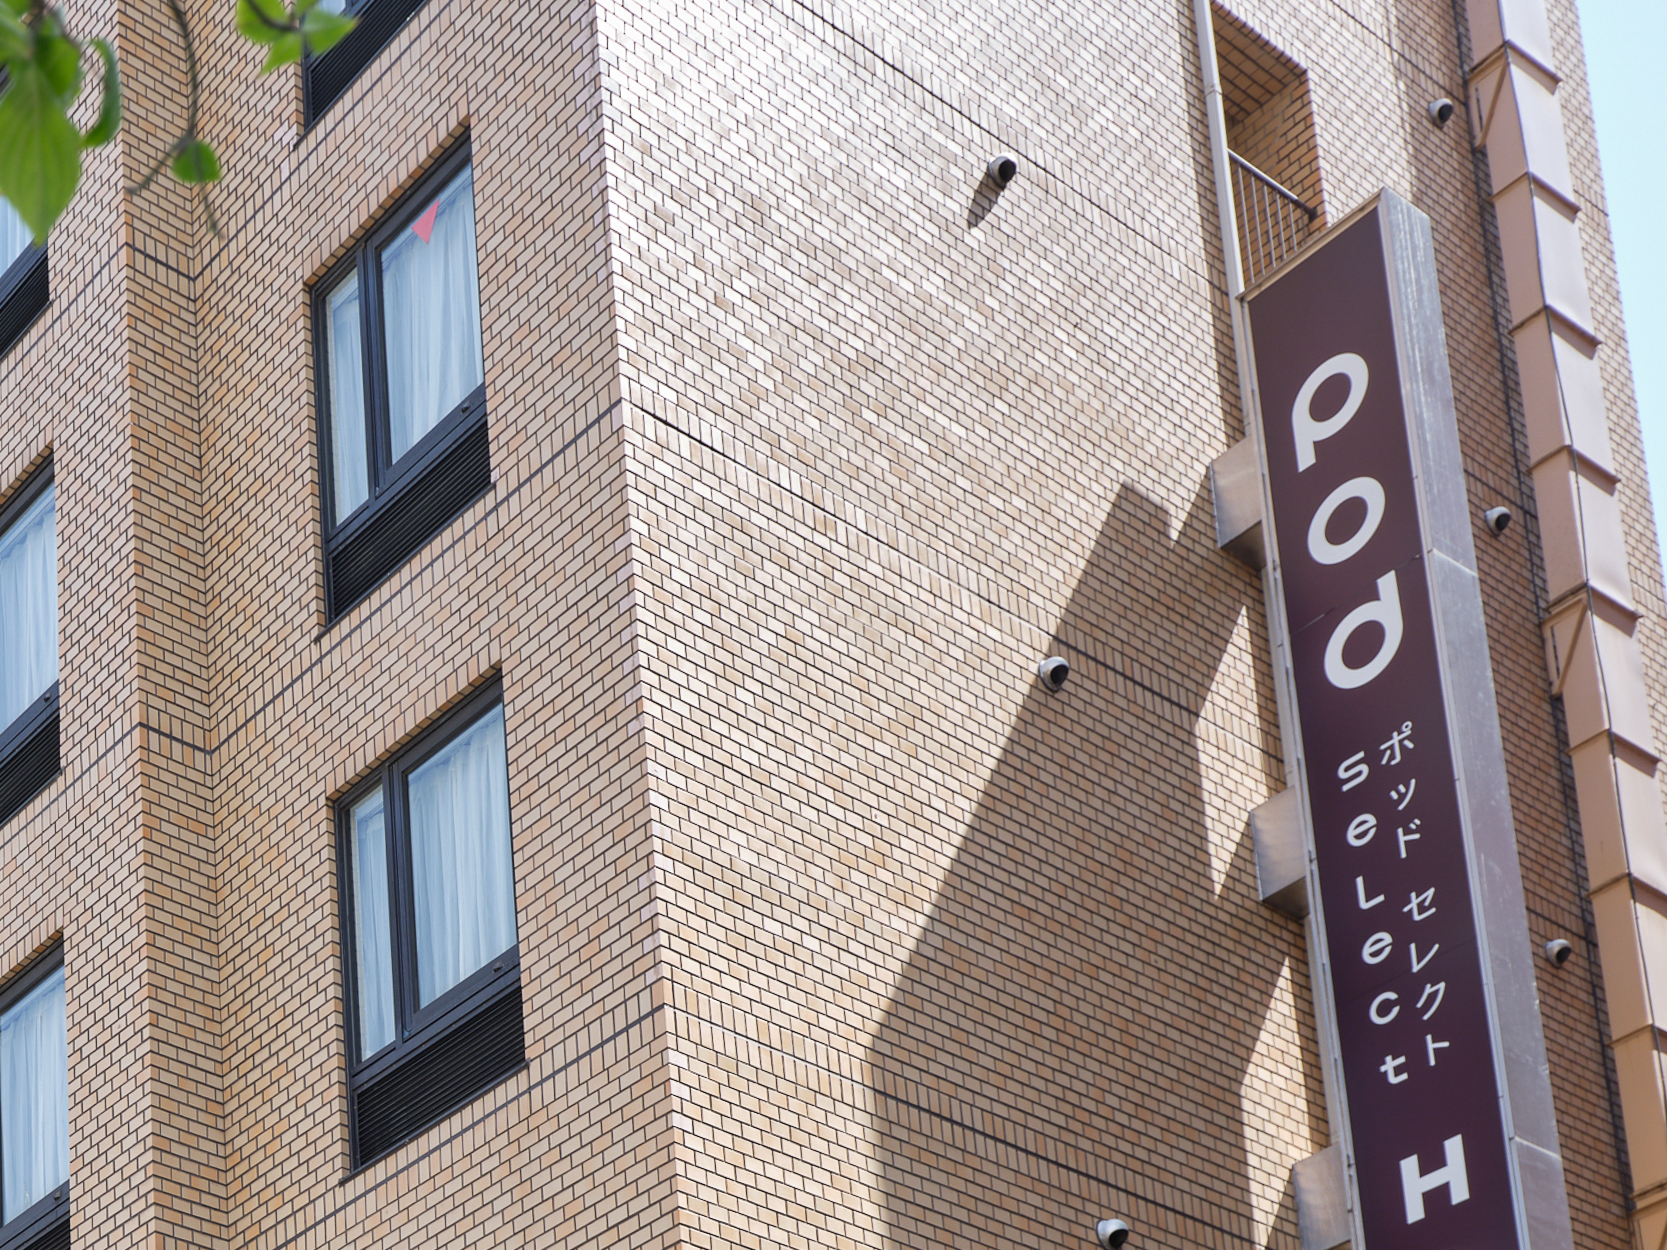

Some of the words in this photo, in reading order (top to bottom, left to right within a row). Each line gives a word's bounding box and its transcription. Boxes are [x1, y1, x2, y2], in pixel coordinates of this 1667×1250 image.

[1292, 352, 1404, 689] pod
[1379, 721, 1421, 859] ポッド
[1402, 887, 1450, 1066] セレクト
